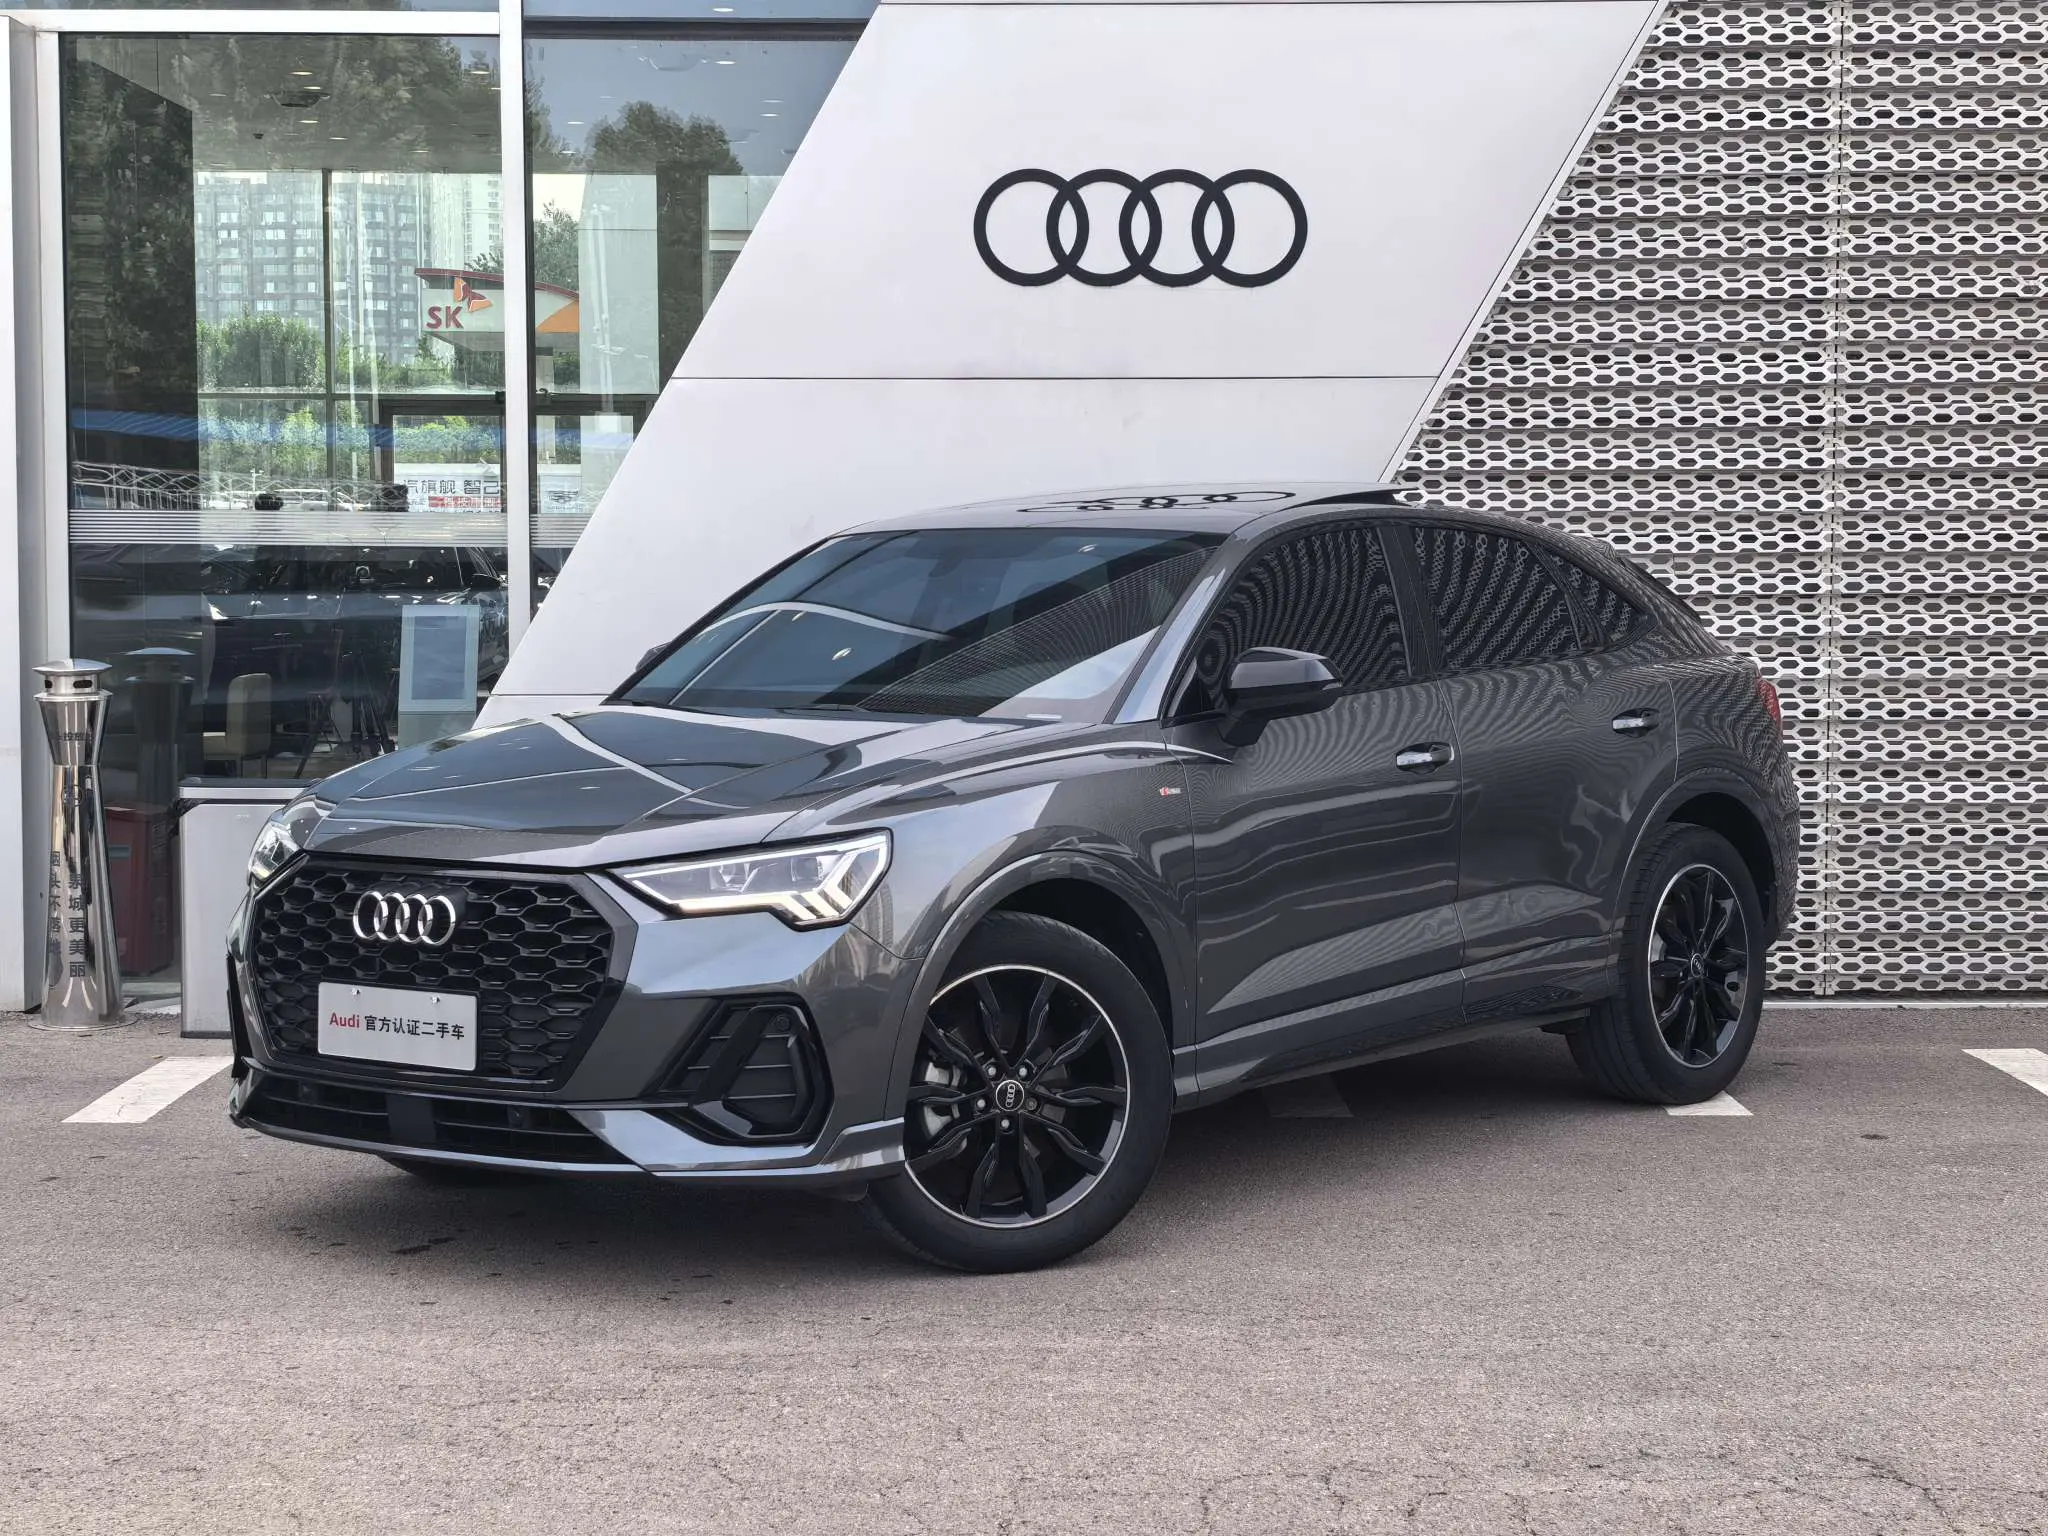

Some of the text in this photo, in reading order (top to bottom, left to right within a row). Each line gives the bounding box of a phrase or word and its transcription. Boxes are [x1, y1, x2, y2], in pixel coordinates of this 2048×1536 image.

[426, 306, 464, 329] SK
[329, 1012, 465, 1040] Audi 官方认证二手车
